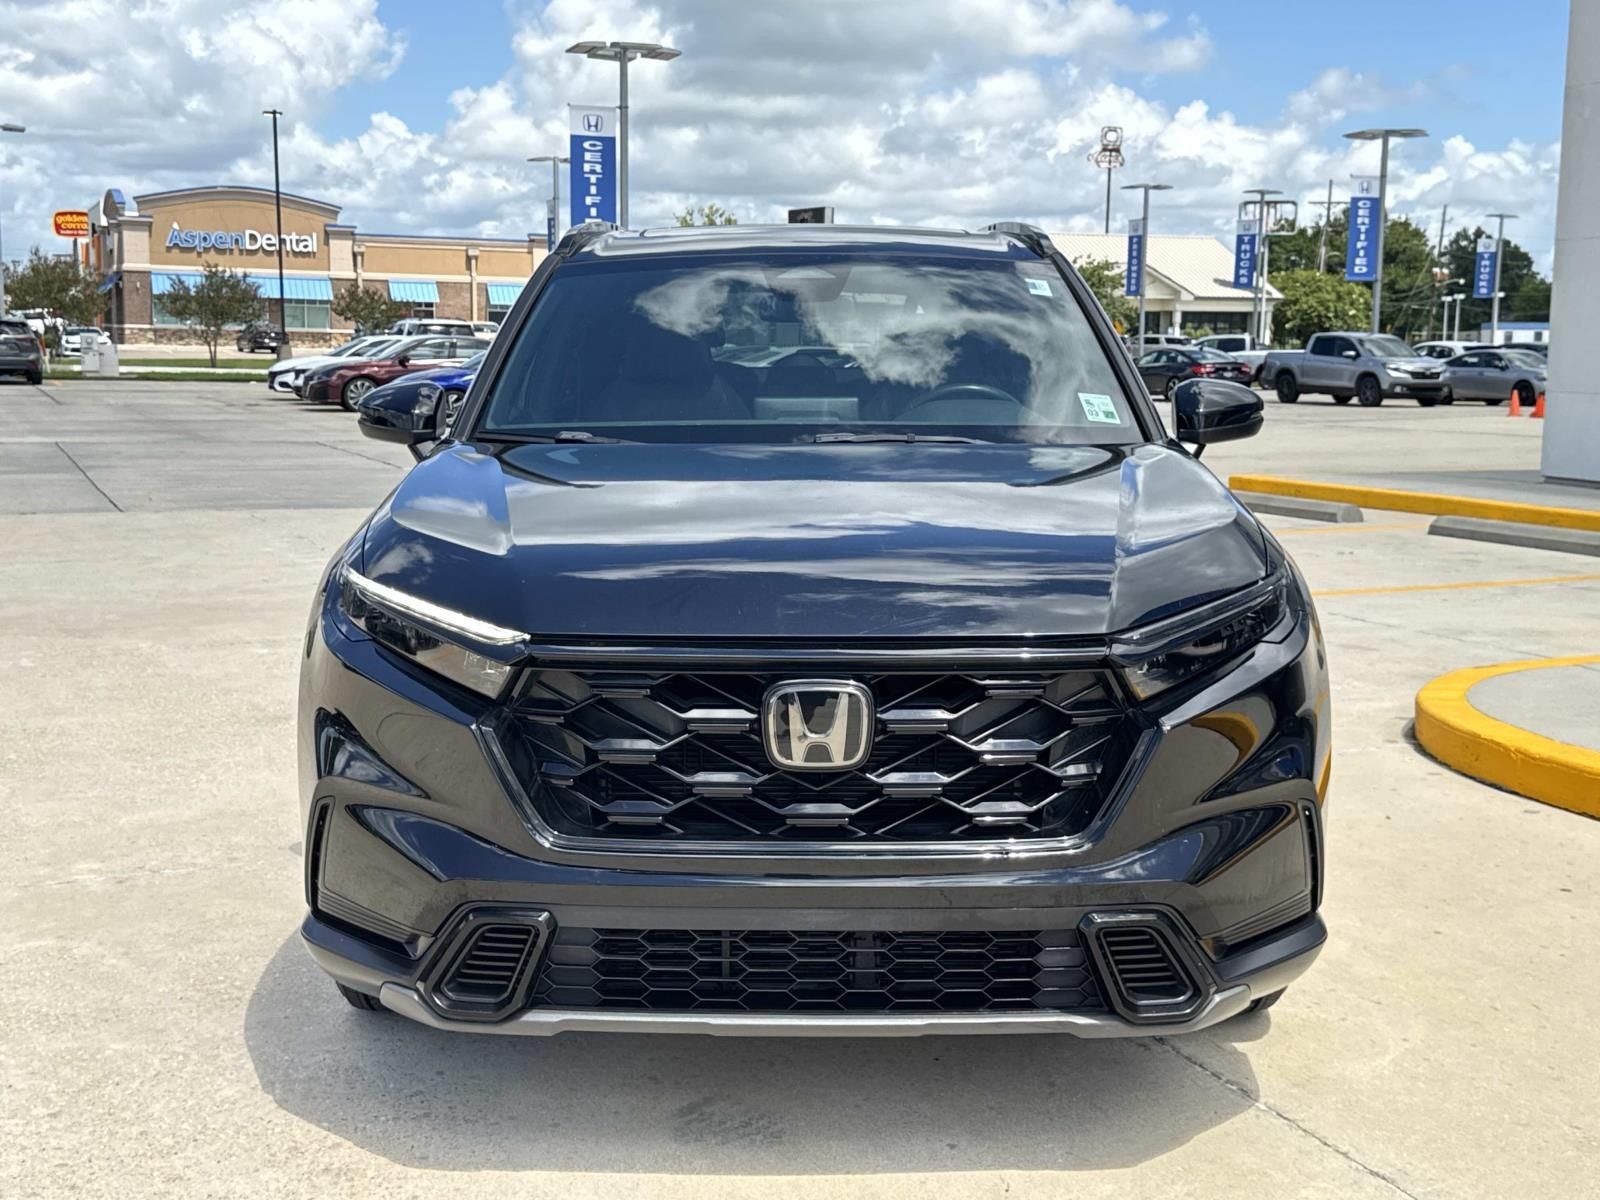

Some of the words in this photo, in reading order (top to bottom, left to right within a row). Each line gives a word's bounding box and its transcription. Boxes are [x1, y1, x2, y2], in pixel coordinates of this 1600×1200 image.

[582, 140, 604, 223] CERTIFI
[1239, 235, 1252, 285] TRUCKS
[1353, 199, 1372, 275] CERTIFIED
[1476, 253, 1490, 294] TRUCKS
